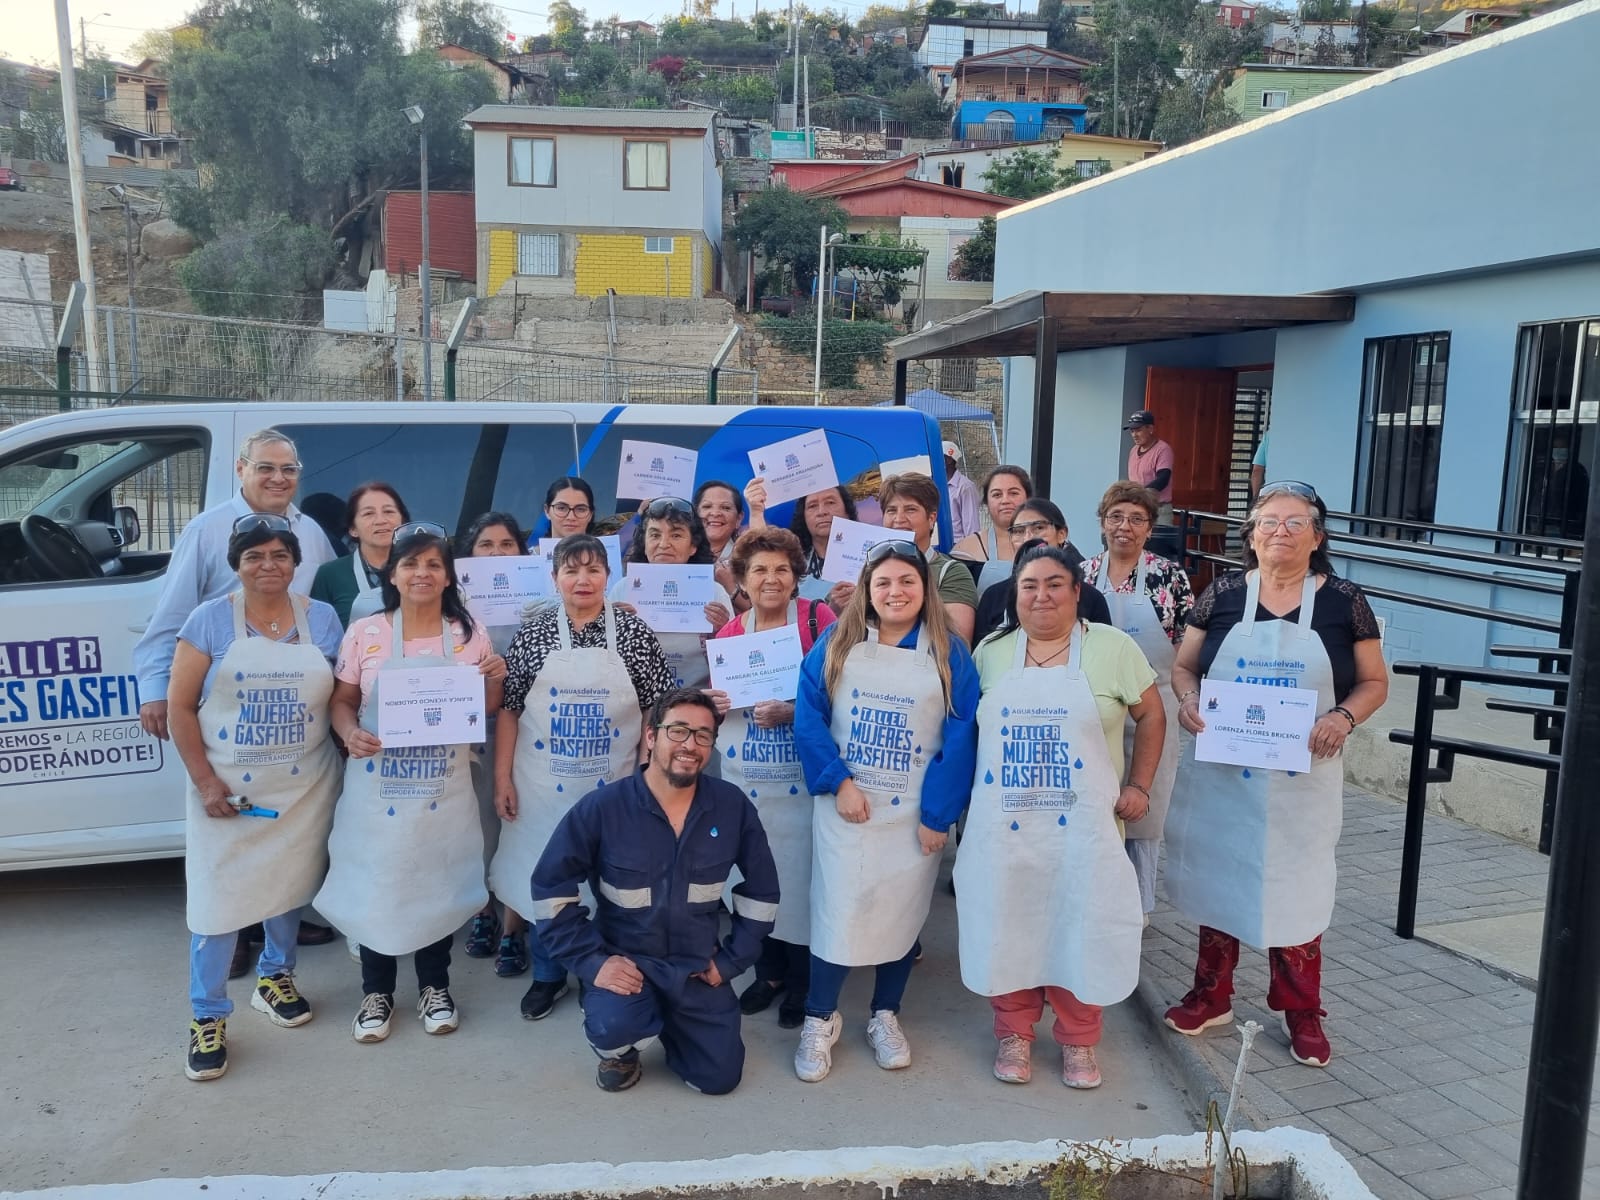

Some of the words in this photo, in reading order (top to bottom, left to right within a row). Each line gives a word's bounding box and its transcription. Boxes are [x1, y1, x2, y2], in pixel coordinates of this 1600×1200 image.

[725, 671, 758, 681] MARGARITA
[248, 688, 297, 703] TALLER
[238, 702, 307, 724] MUJERES
[561, 703, 603, 717] TALLER
[862, 708, 906, 727] TALLER
[66, 731, 86, 745] LA
[234, 723, 304, 746] GASFITER
[550, 717, 611, 738] MUJERES
[850, 721, 914, 751] MUJERES
[1013, 726, 1060, 740] TALLER
[1214, 725, 1245, 734] LORENZA
[1246, 728, 1270, 737] FLORES
[550, 737, 611, 758] GASFITER
[846, 742, 912, 772] GASFITER
[1003, 741, 1069, 765] MUJERES
[380, 758, 447, 779] GASFITER
[1001, 765, 1071, 789] GASFITER
